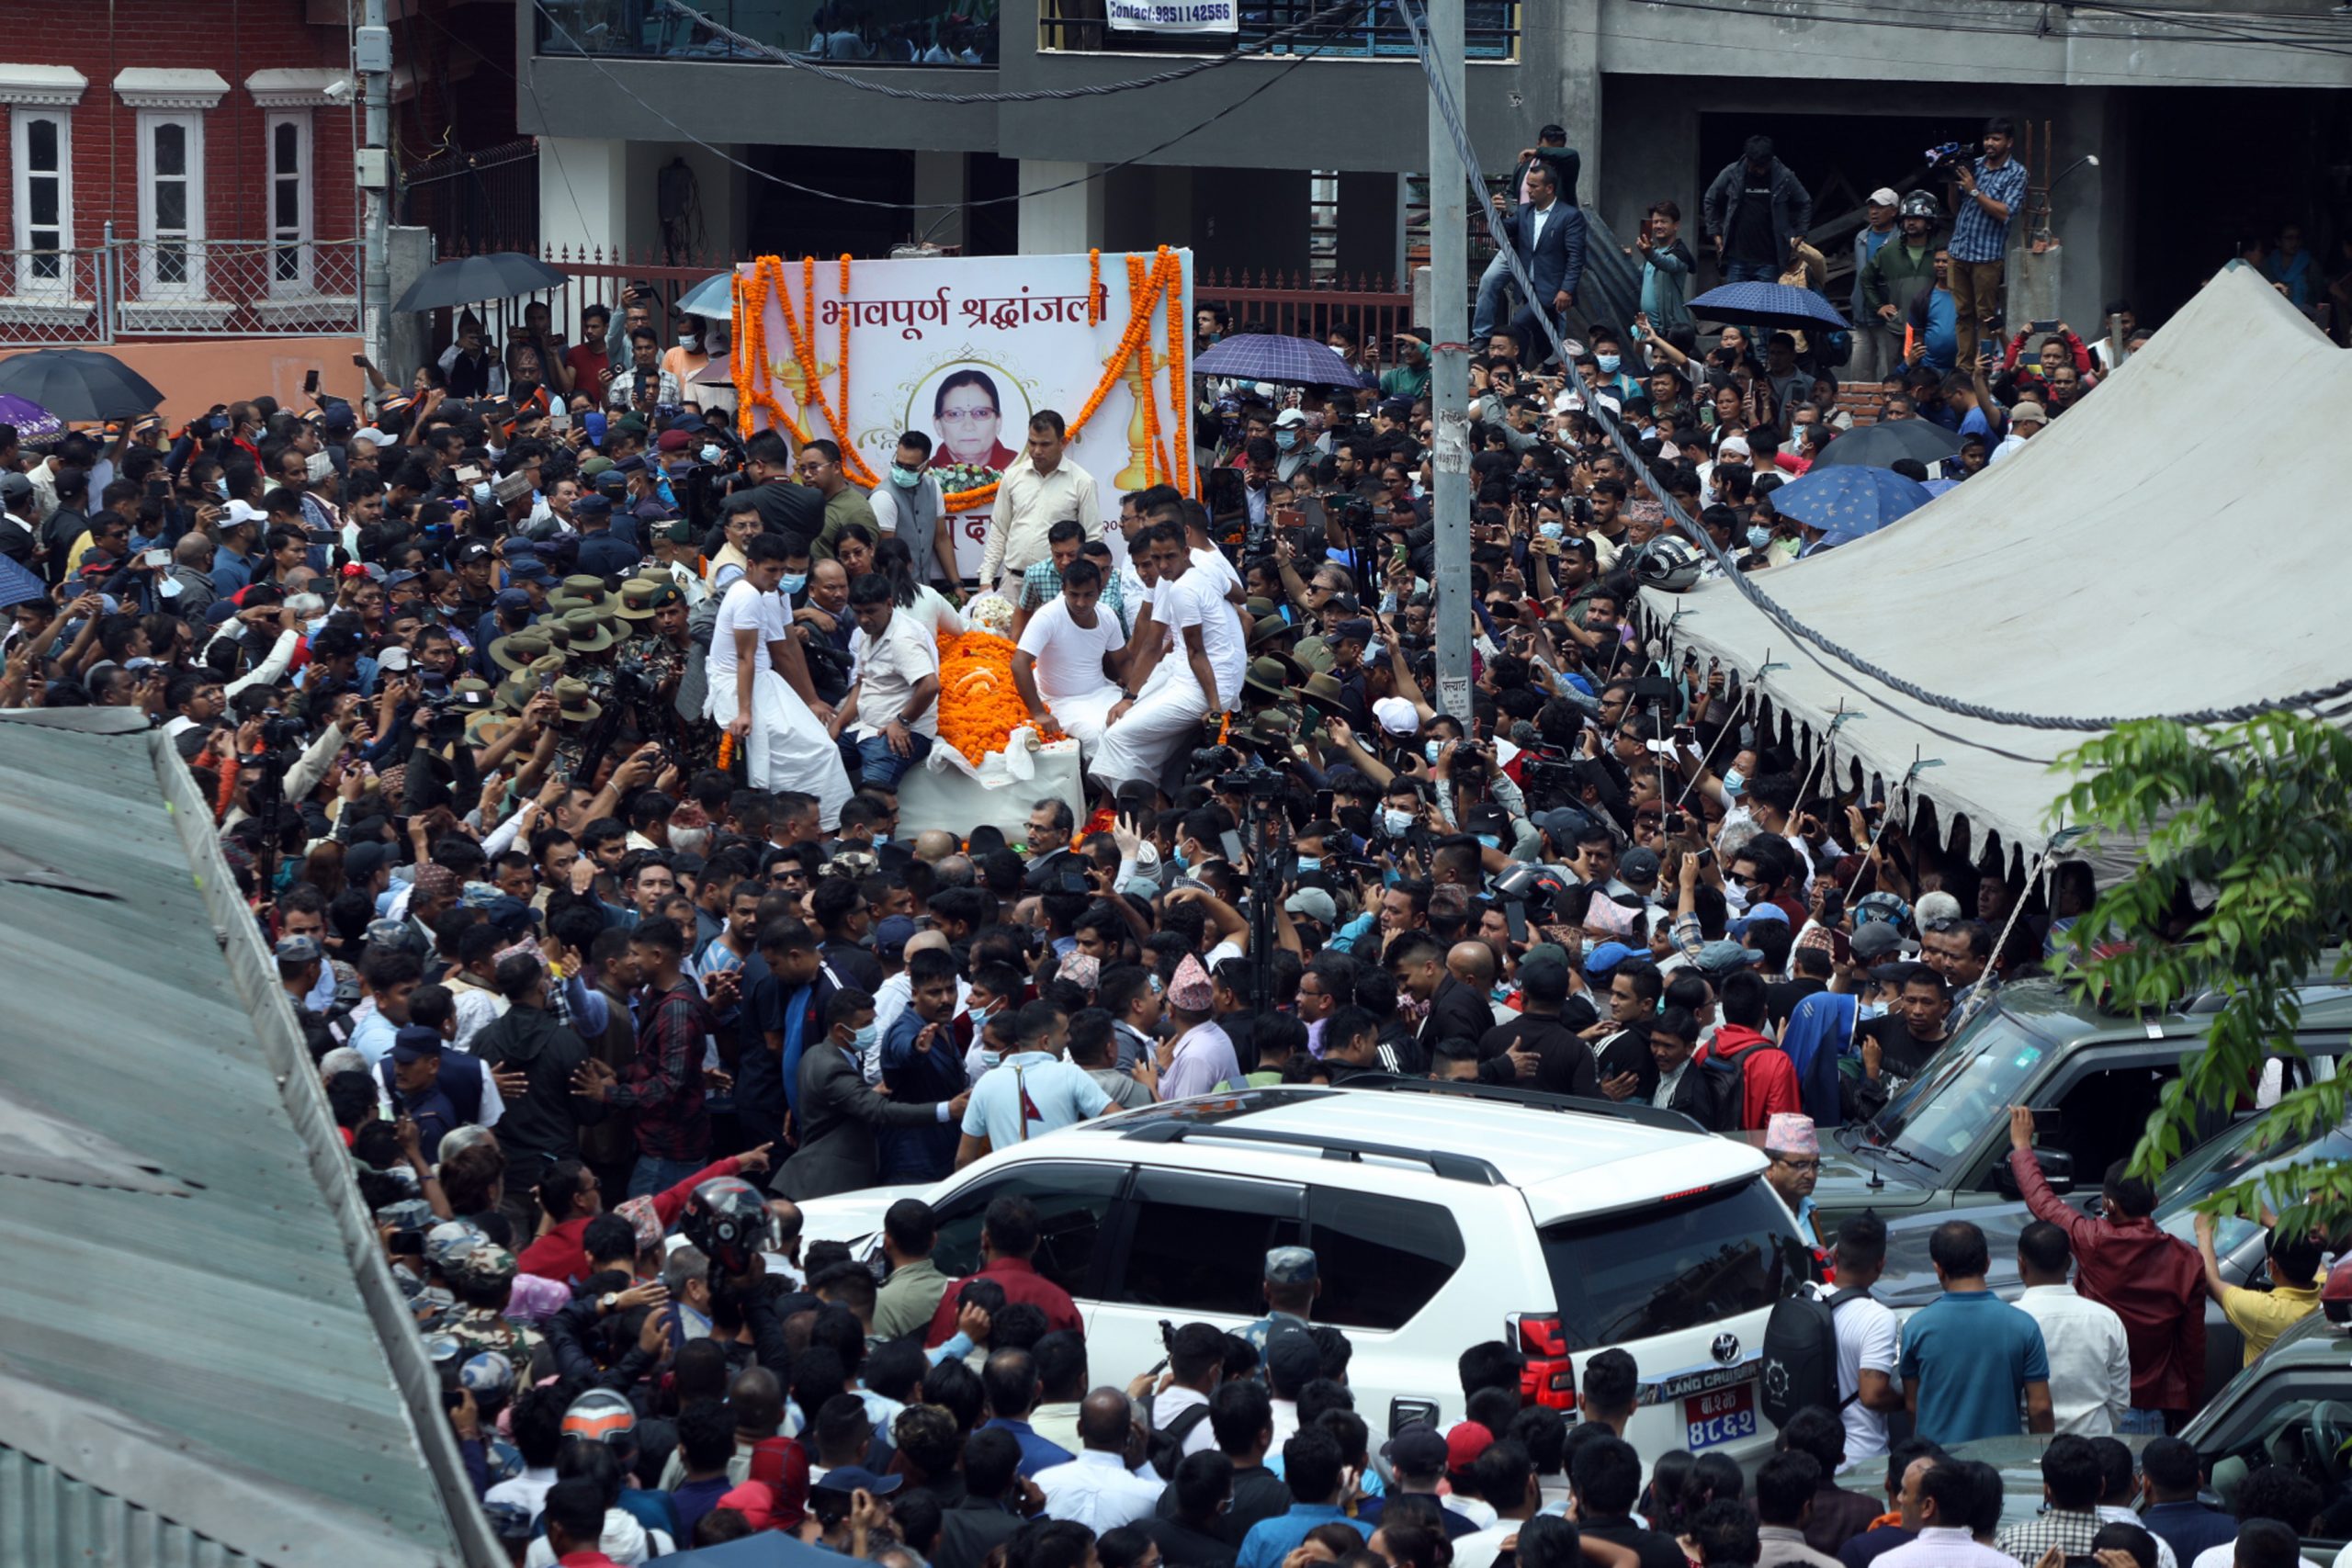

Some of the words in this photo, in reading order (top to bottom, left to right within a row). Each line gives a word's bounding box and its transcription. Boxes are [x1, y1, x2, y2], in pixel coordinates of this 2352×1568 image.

[821, 286, 951, 341] भावपूर्ण
[1667, 1377, 1702, 1396] LAND
[1704, 1364, 1757, 1387] CRUISER
[1690, 1410, 1754, 1446] ४८६२
